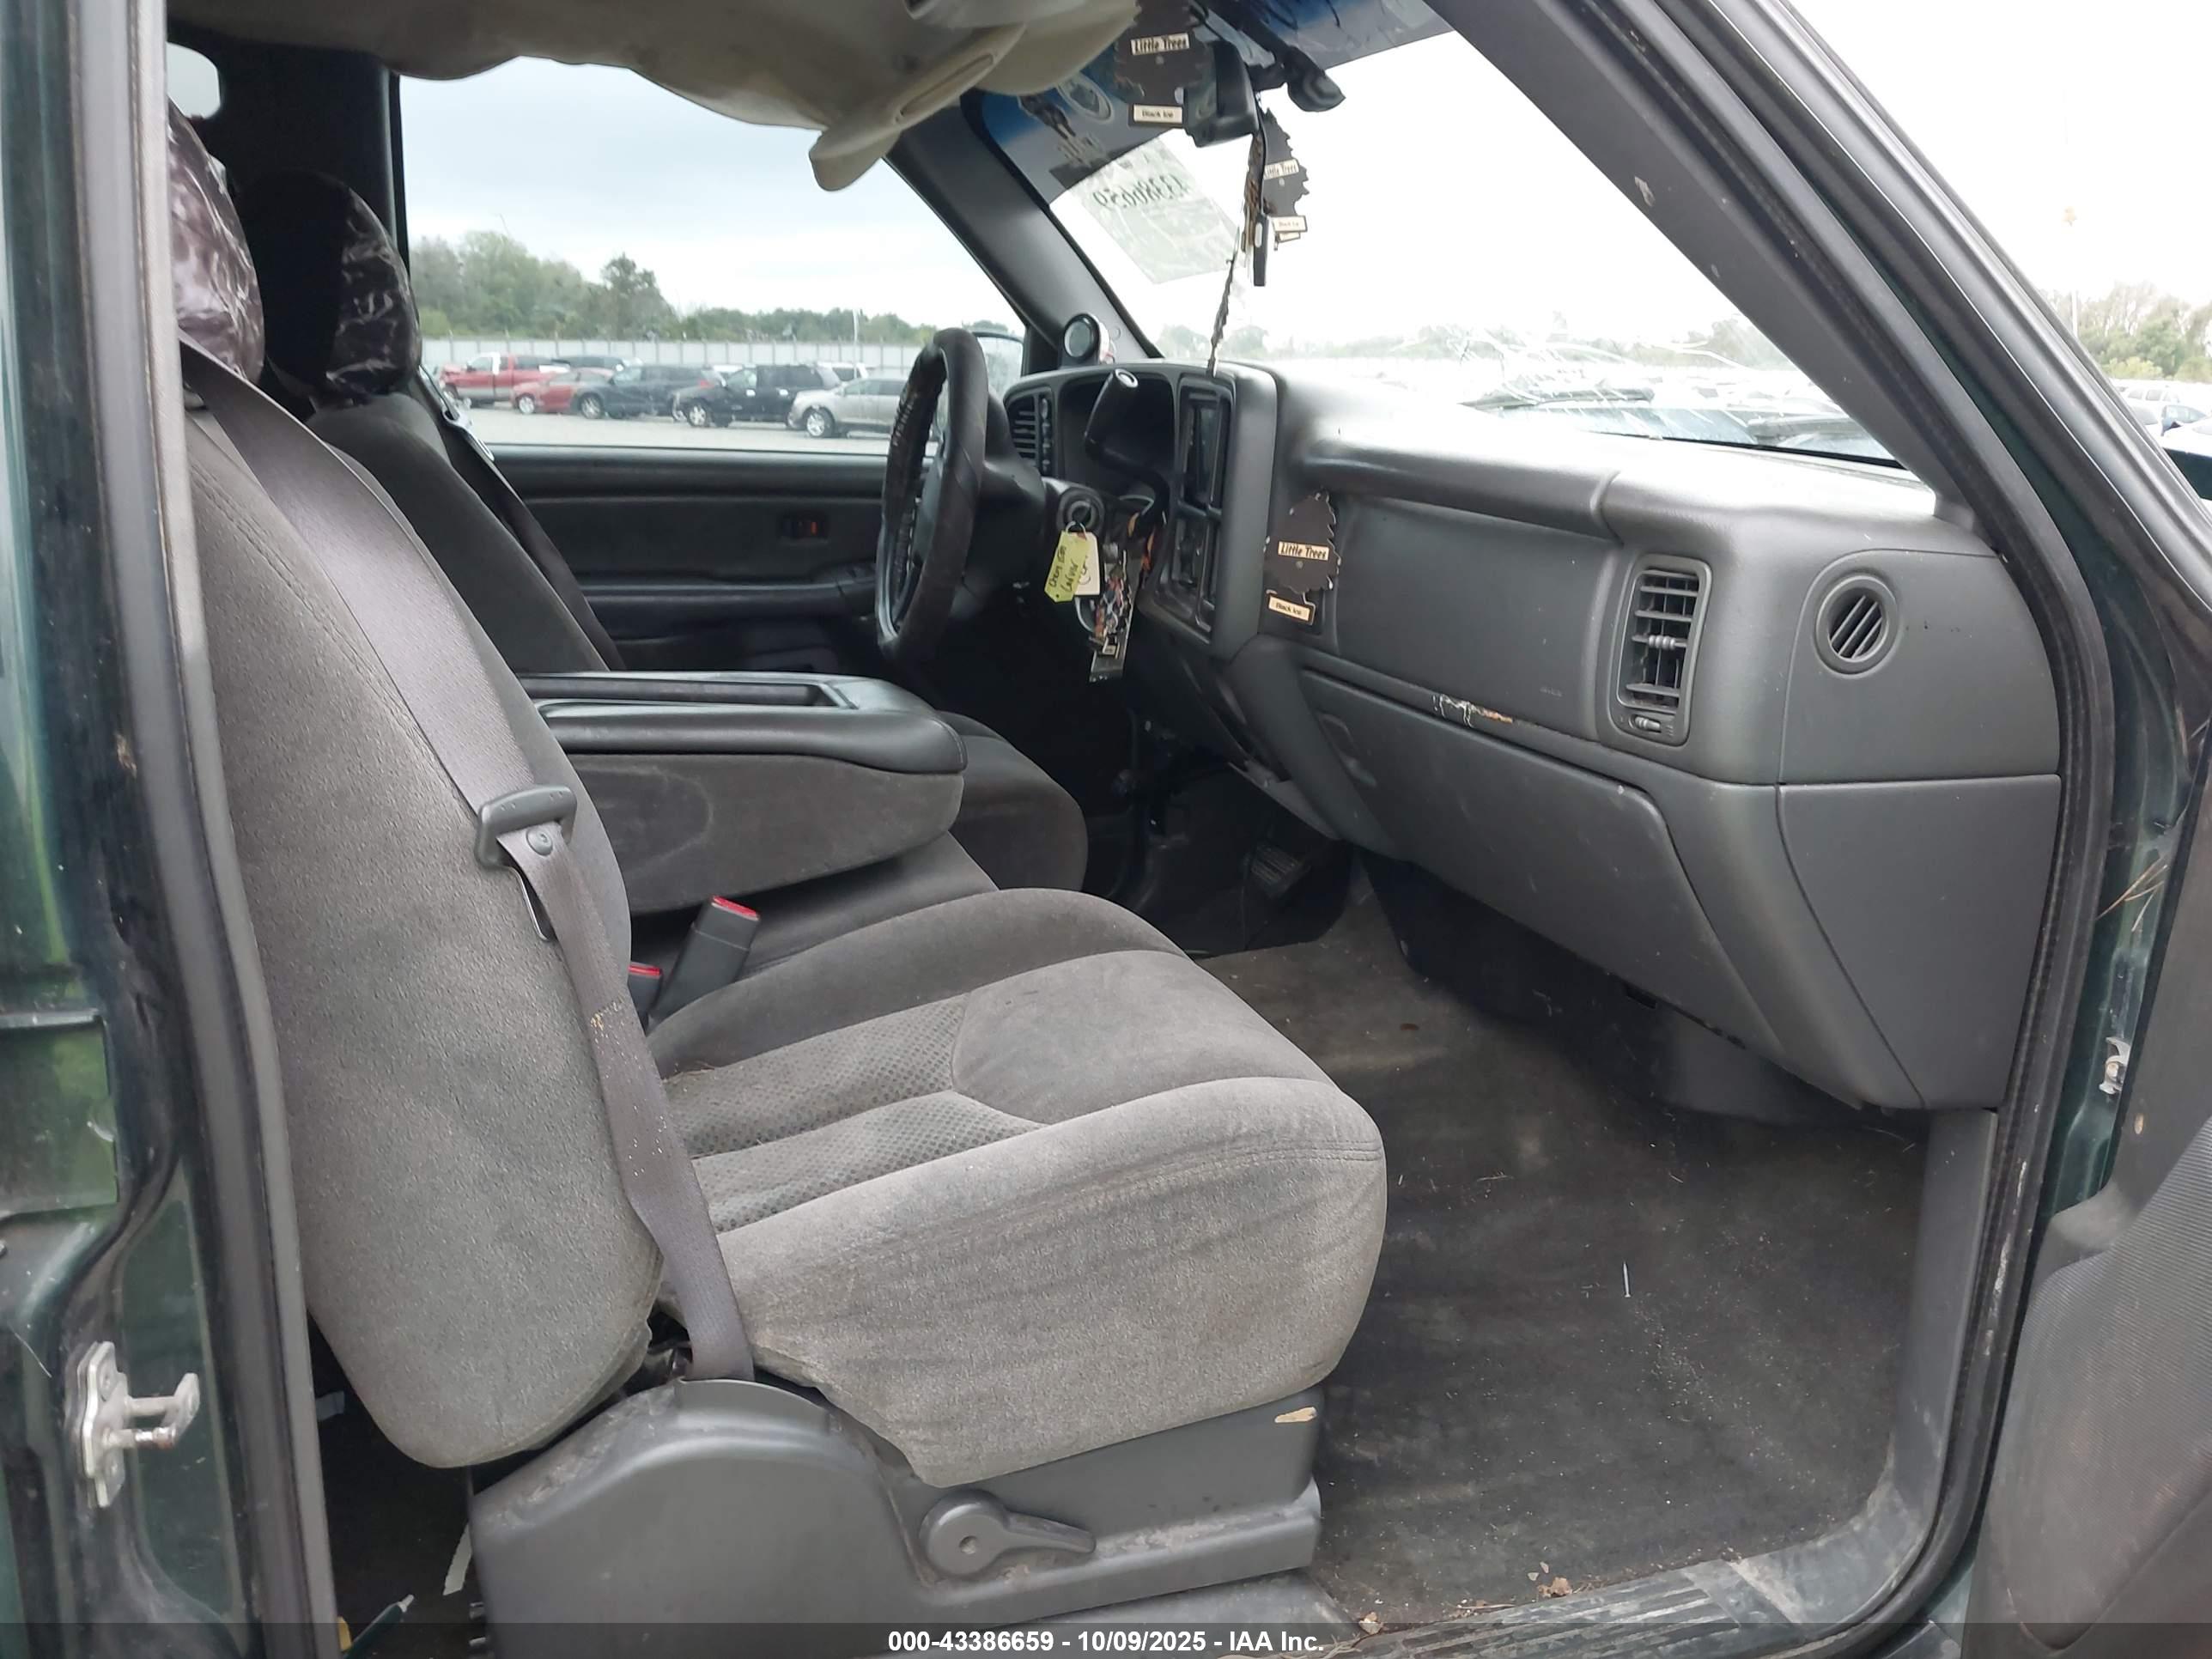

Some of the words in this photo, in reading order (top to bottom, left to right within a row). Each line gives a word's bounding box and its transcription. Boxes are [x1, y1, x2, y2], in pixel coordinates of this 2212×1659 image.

[1134, 36, 1159, 53] Little
[1161, 34, 1187, 51] Trees
[1280, 543, 1303, 556] Little
[1305, 547, 1327, 559] Trees
